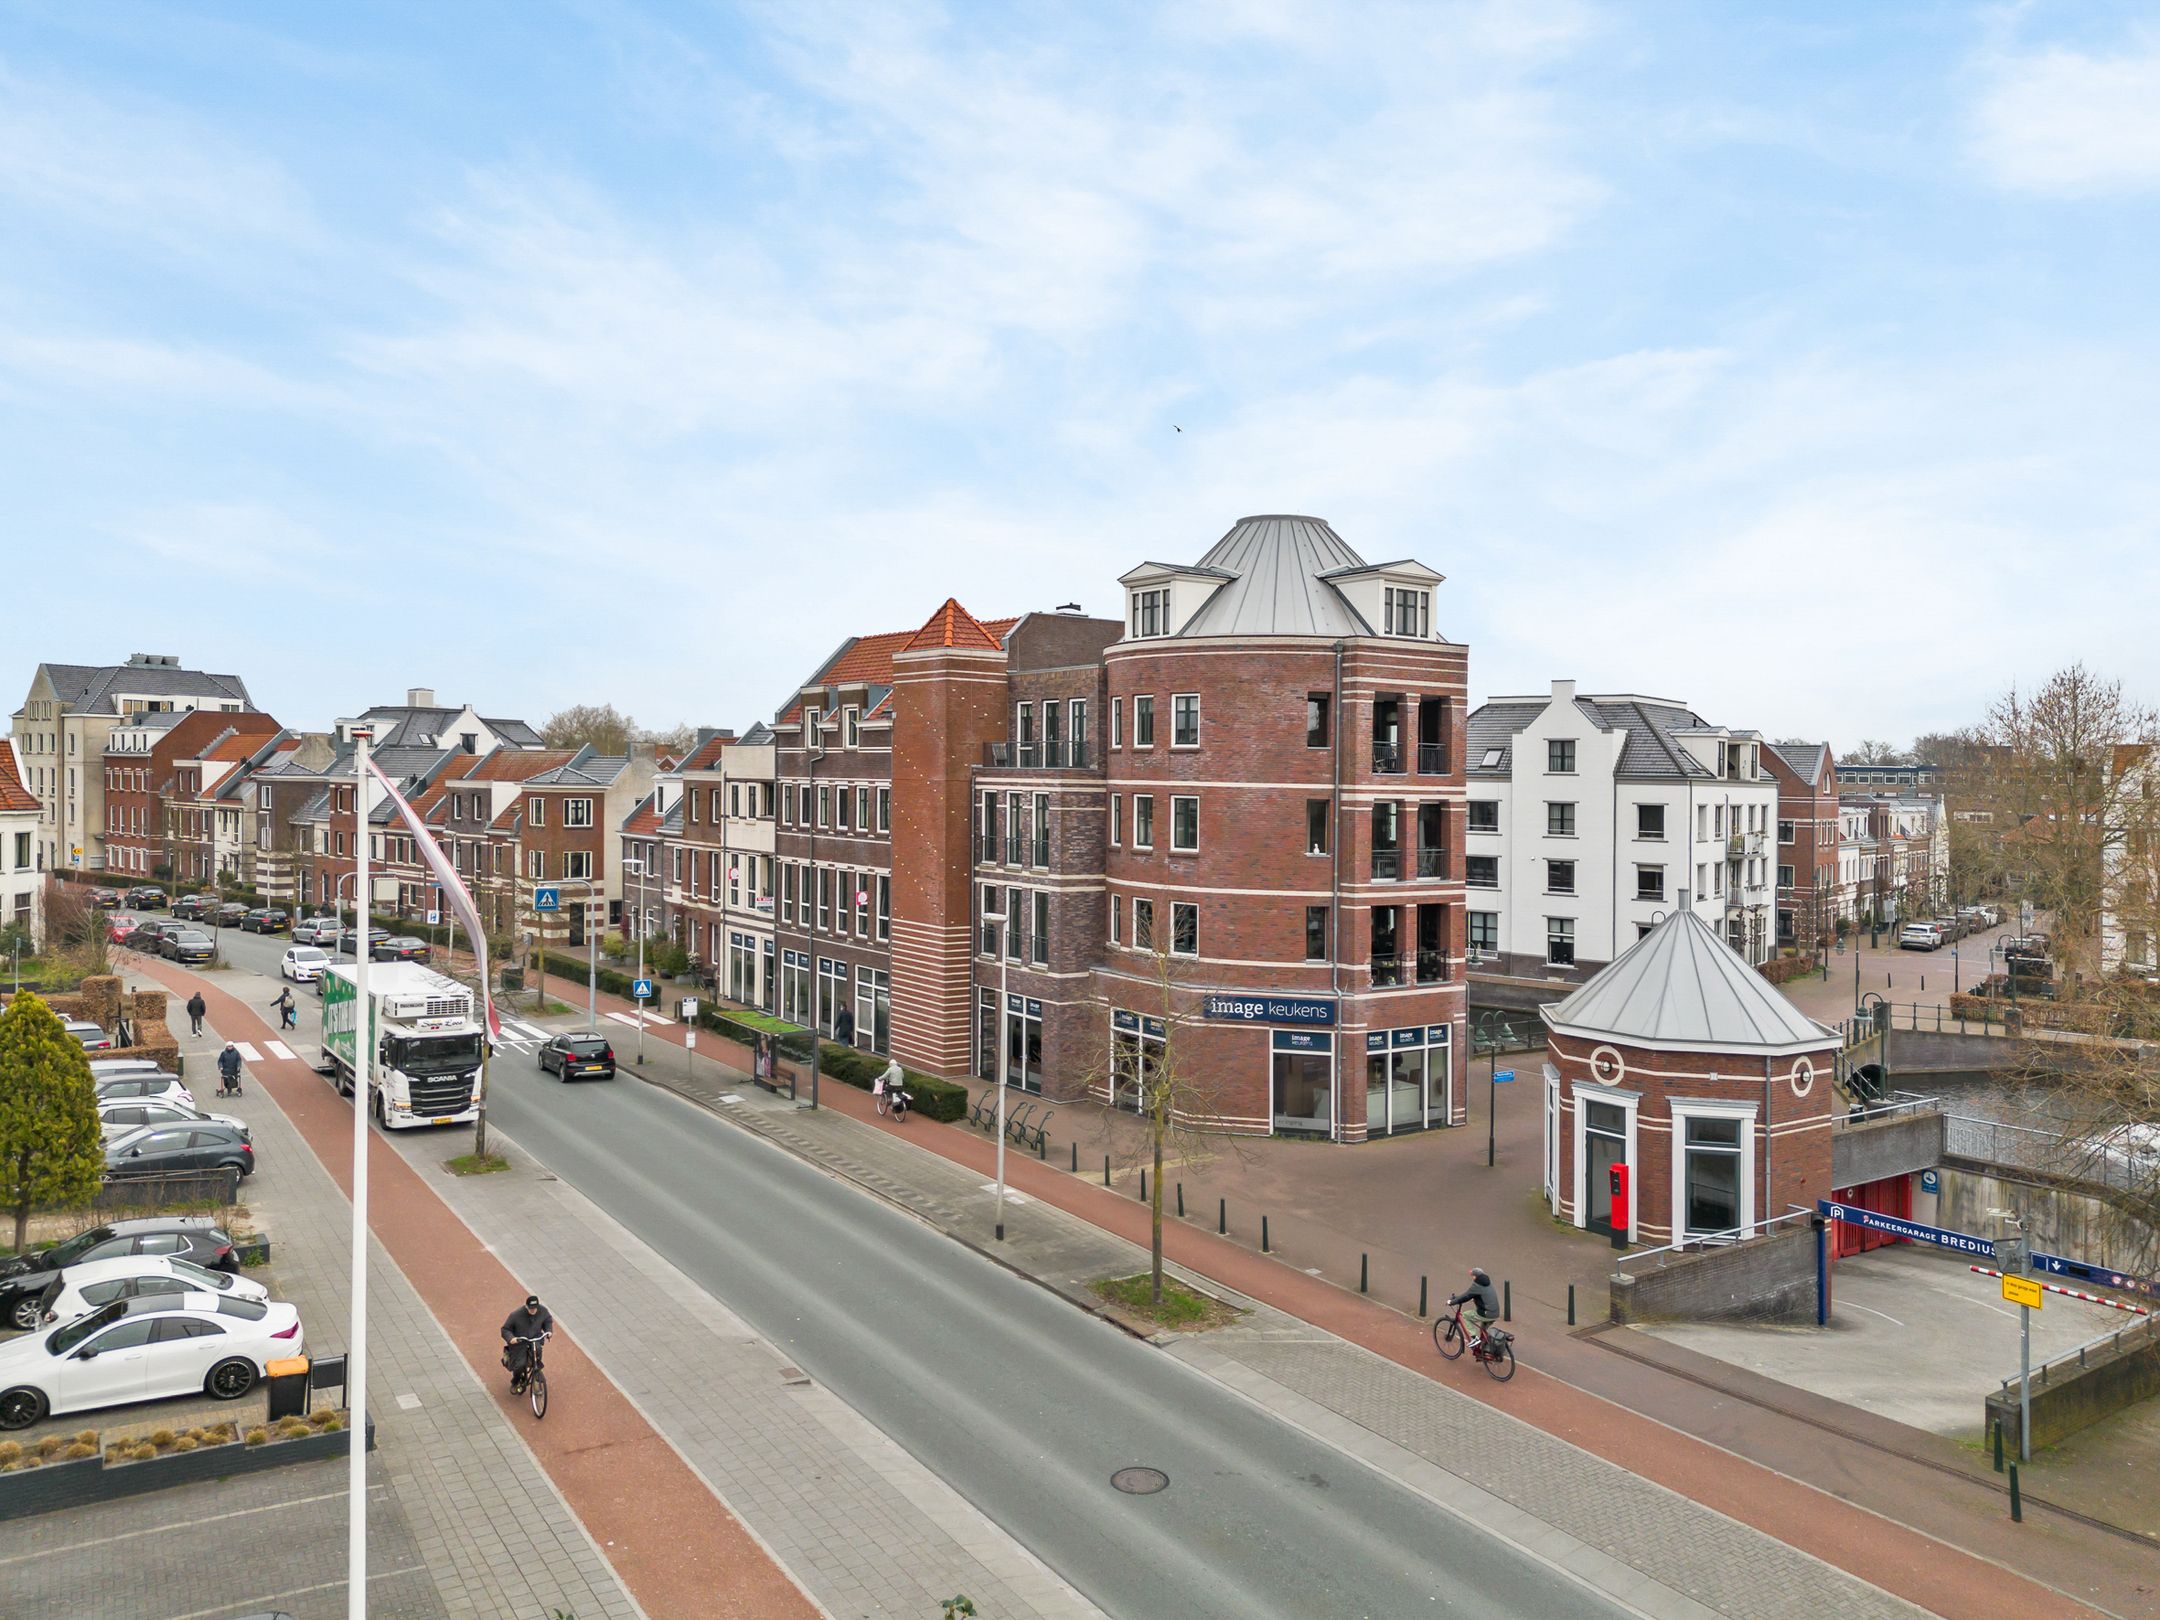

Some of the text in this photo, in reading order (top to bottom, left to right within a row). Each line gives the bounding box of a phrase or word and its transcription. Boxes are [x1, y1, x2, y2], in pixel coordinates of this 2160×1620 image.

[1211, 998, 1328, 1018] image keukens
[1291, 1034, 1311, 1042] image
[427, 1074, 458, 1083] SCANIA
[1863, 1214, 1937, 1241] PARKEERGARAGE
[1941, 1234, 1996, 1256] BREDIUS
